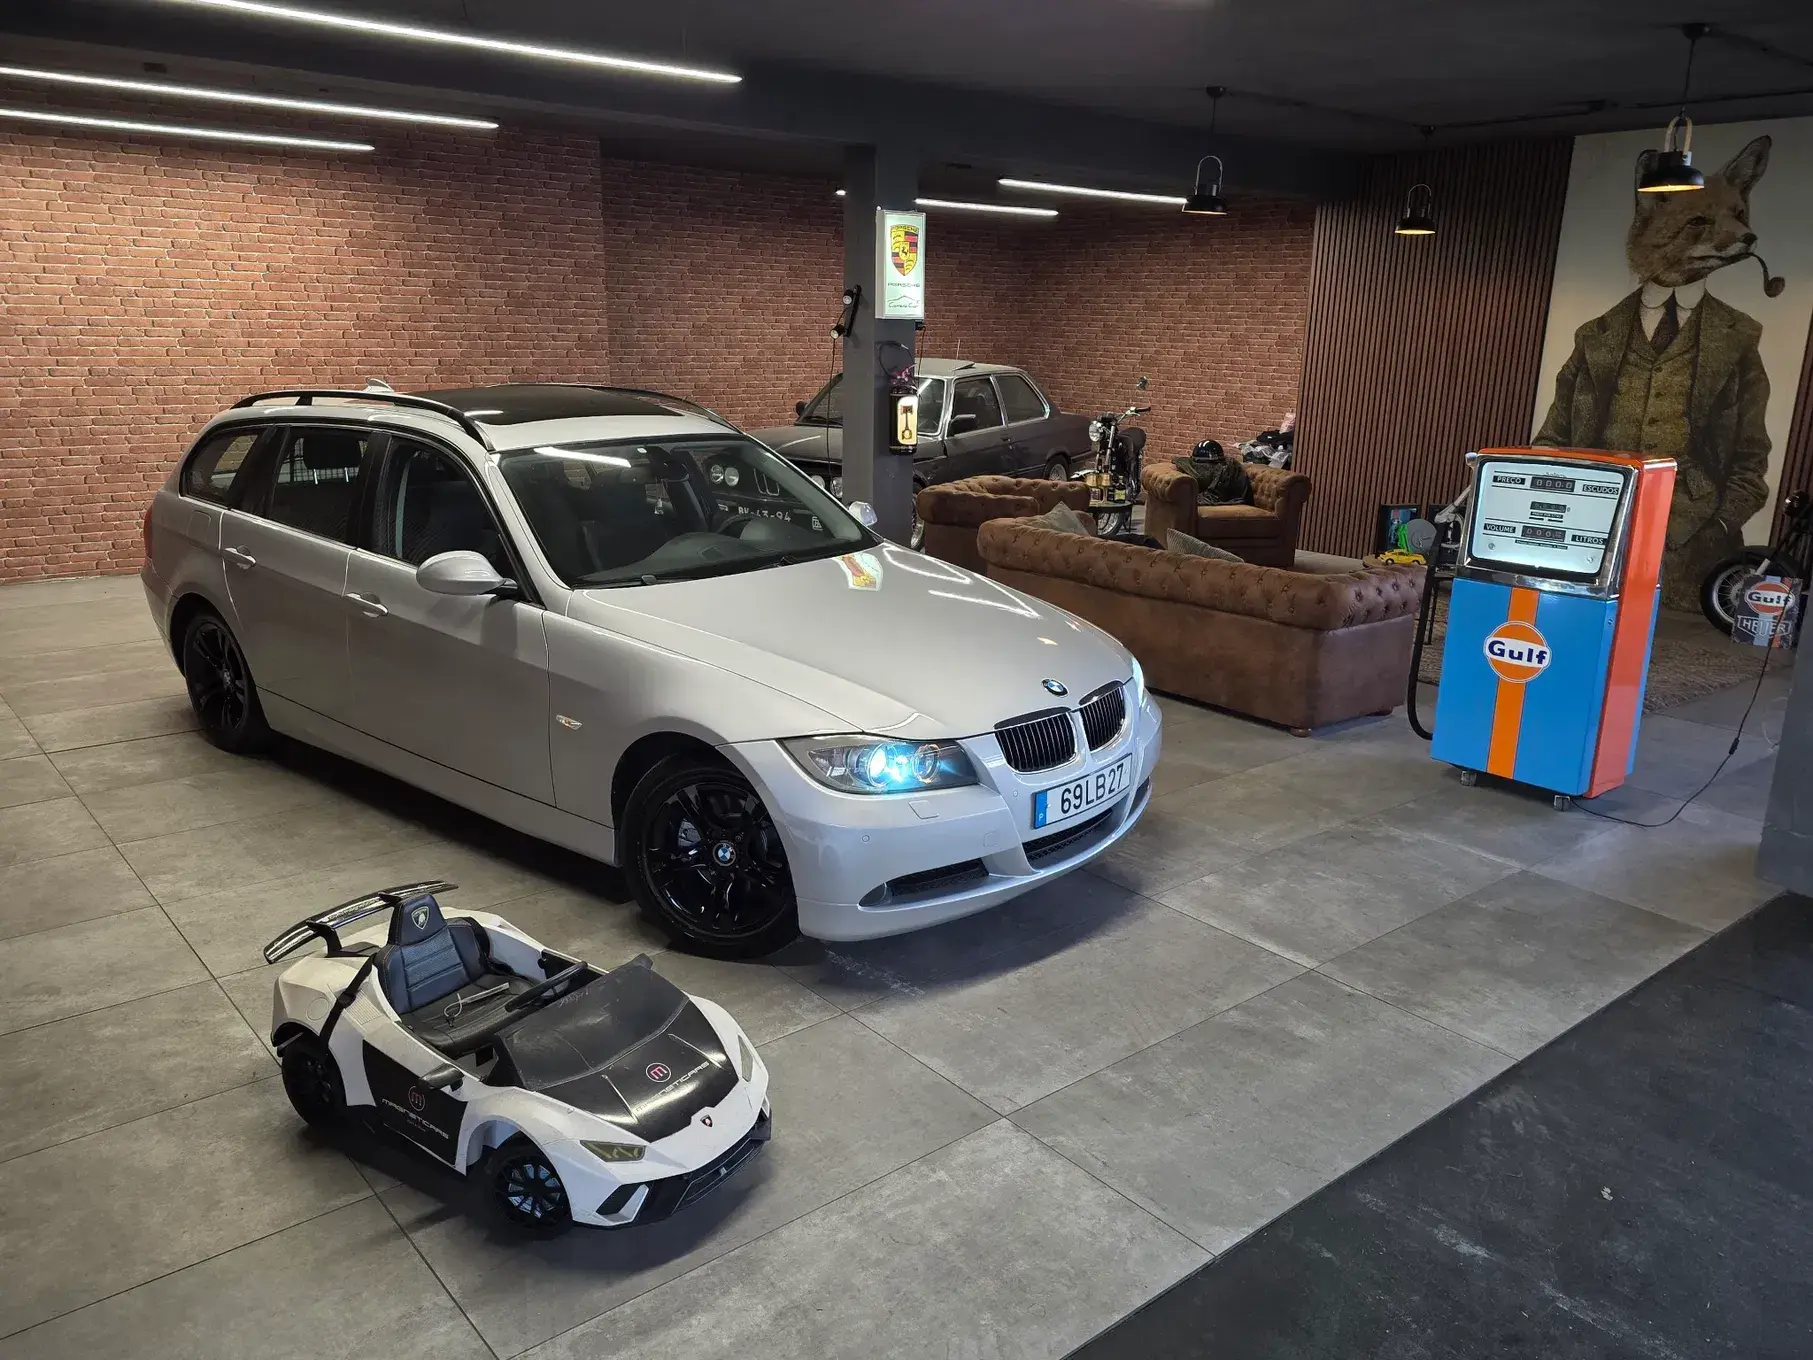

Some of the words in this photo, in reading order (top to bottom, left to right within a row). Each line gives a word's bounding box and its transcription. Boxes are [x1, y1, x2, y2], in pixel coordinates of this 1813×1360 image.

[1497, 475, 1522, 485] PREÇO
[1583, 484, 1619, 495] ESCUDOS
[1486, 523, 1515, 533] VOLUME
[1575, 535, 1604, 545] LITROS
[1748, 592, 1791, 604] Gulf
[1742, 619, 1786, 637] HEUER
[1488, 640, 1548, 665] Gulf
[1061, 762, 1124, 815] 69LB27
